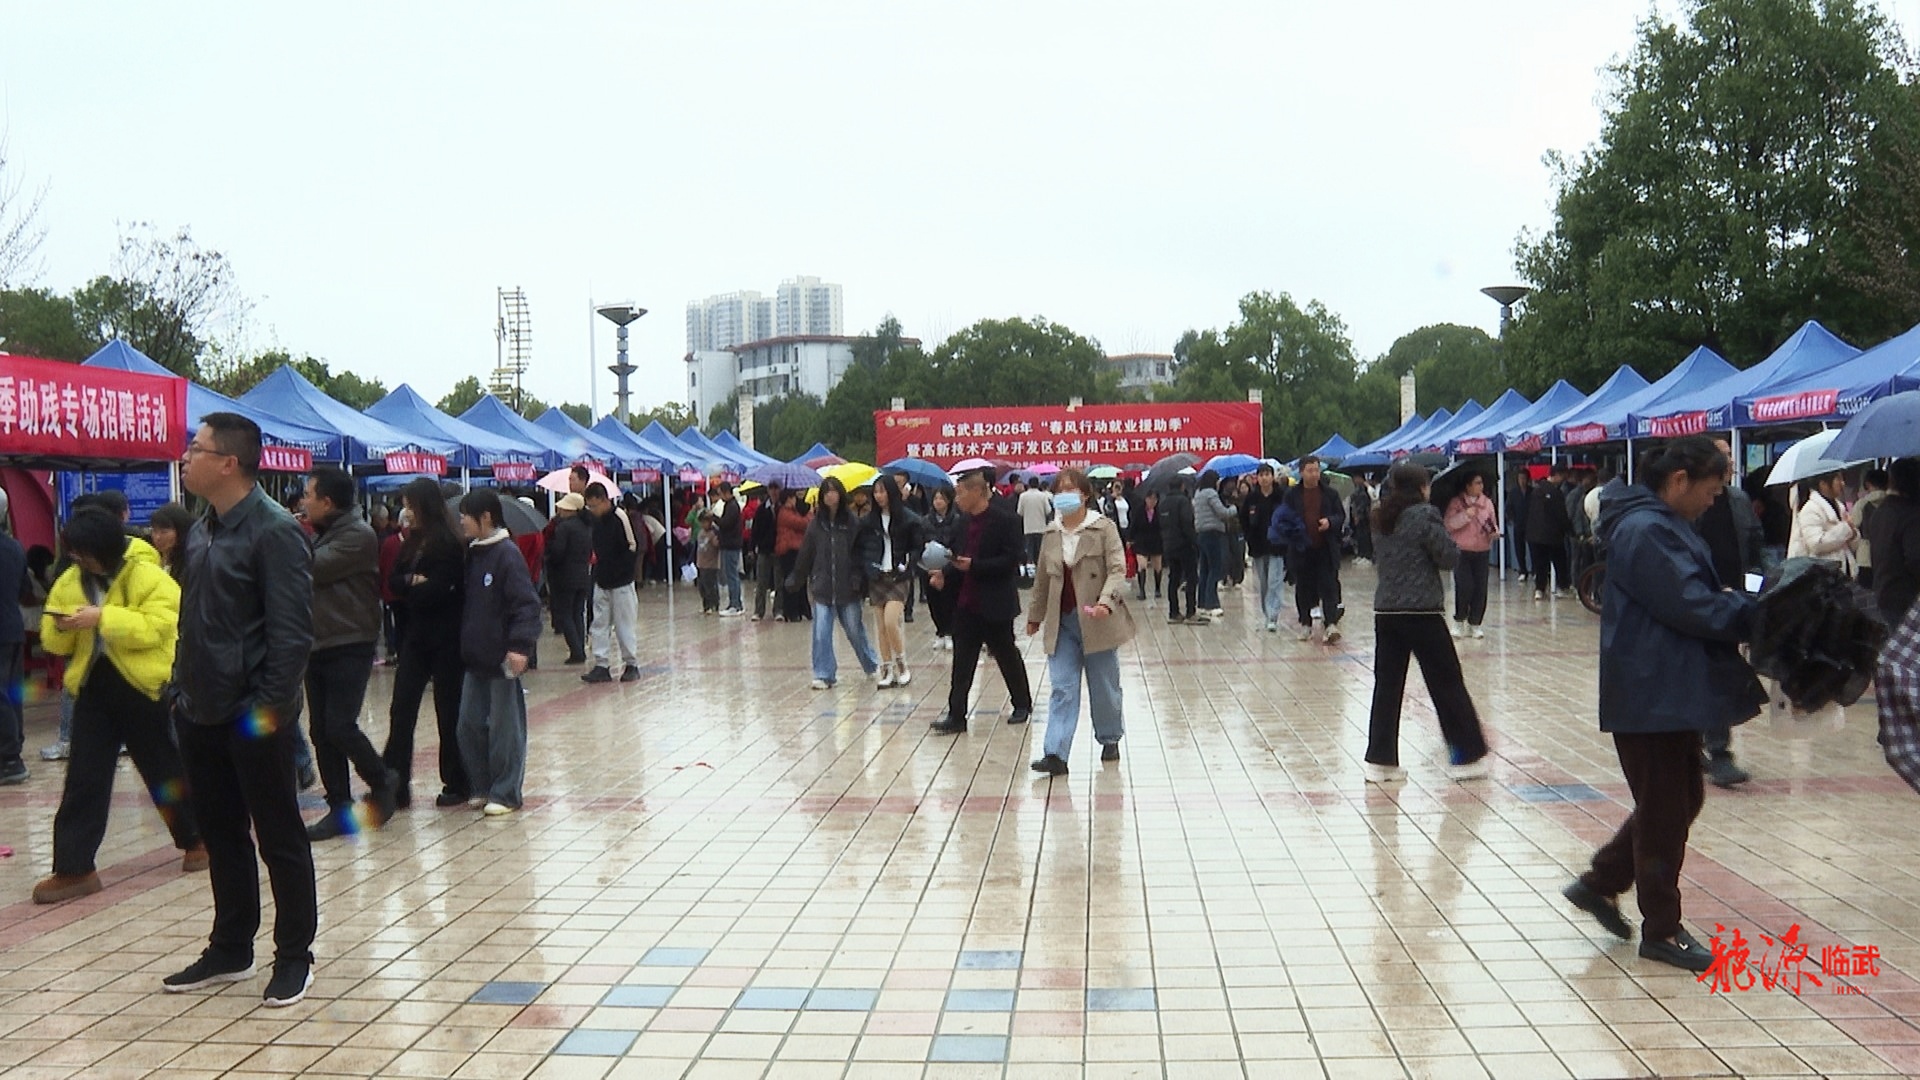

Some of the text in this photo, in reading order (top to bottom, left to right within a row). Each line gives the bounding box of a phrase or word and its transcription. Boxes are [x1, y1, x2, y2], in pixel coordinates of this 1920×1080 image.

[0, 376, 168, 443] 季助残专场招聘活动
[906, 437, 1234, 458] 暨高新技术产业开发区企业用工送工系列招聘活动
